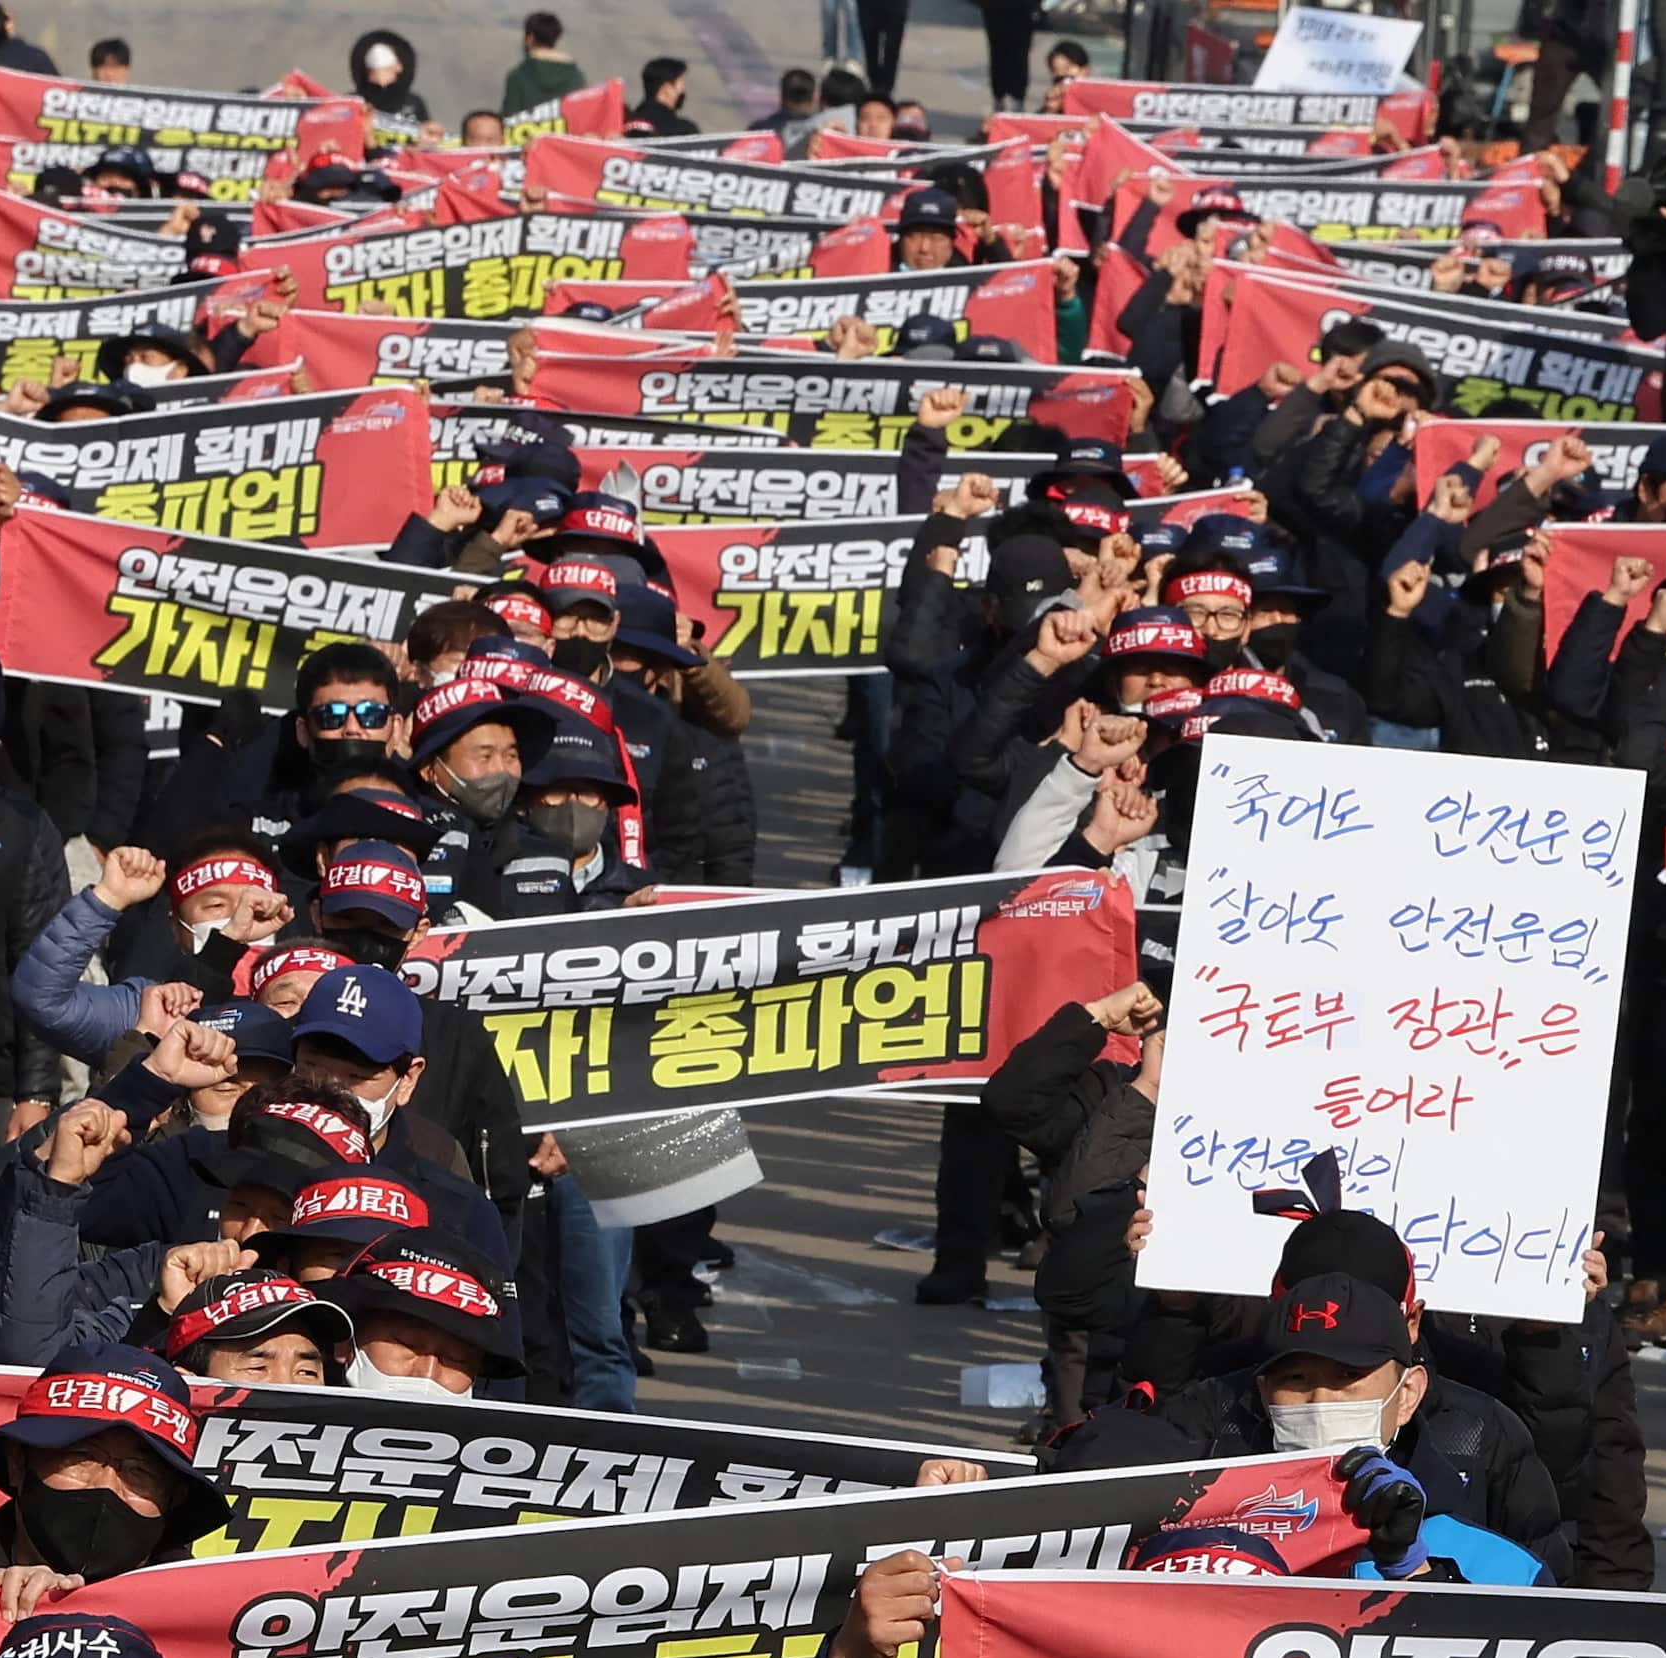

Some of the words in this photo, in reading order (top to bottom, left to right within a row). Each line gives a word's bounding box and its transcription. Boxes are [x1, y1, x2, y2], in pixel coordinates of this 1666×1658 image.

[42, 88, 214, 135] 안전운임제
[214, 99, 299, 138] 확대!
[1133, 91, 1290, 126] 안전운임제
[1296, 93, 1377, 126] 확대!
[601, 157, 790, 218] 안전운임제
[791, 178, 884, 220] 확대!
[1377, 193, 1466, 228] 확대!
[326, 217, 524, 285] 안전운임제
[526, 217, 624, 261] 확대!
[865, 285, 969, 328] 확대!
[640, 371, 900, 415] 안전운임제
[194, 418, 318, 474] 확대!
[115, 546, 404, 644] 안전운임제
[96, 596, 277, 690] 가자!
[712, 589, 882, 662] 가자!
[1108, 630, 1140, 652] 단결
[1159, 627, 1194, 648] 투쟁
[558, 684, 596, 712] 투쟁
[1208, 675, 1239, 693] 단결
[416, 691, 452, 722] 단결
[176, 867, 211, 894] 단결
[241, 866, 272, 892] 투쟁
[328, 864, 364, 888] 단결
[389, 871, 423, 901] 투쟁
[290, 952, 338, 970] 투쟁
[796, 905, 981, 973] 확대!
[336, 976, 367, 1018] LA
[651, 960, 987, 1090] 총파업!
[1313, 1074, 1475, 1131] 들어라
[1355, 1196, 1591, 1286] 답이다!
[452, 1283, 500, 1318] 투쟁
[46, 1379, 104, 1412] 단결
[147, 1399, 190, 1442] 투쟁
